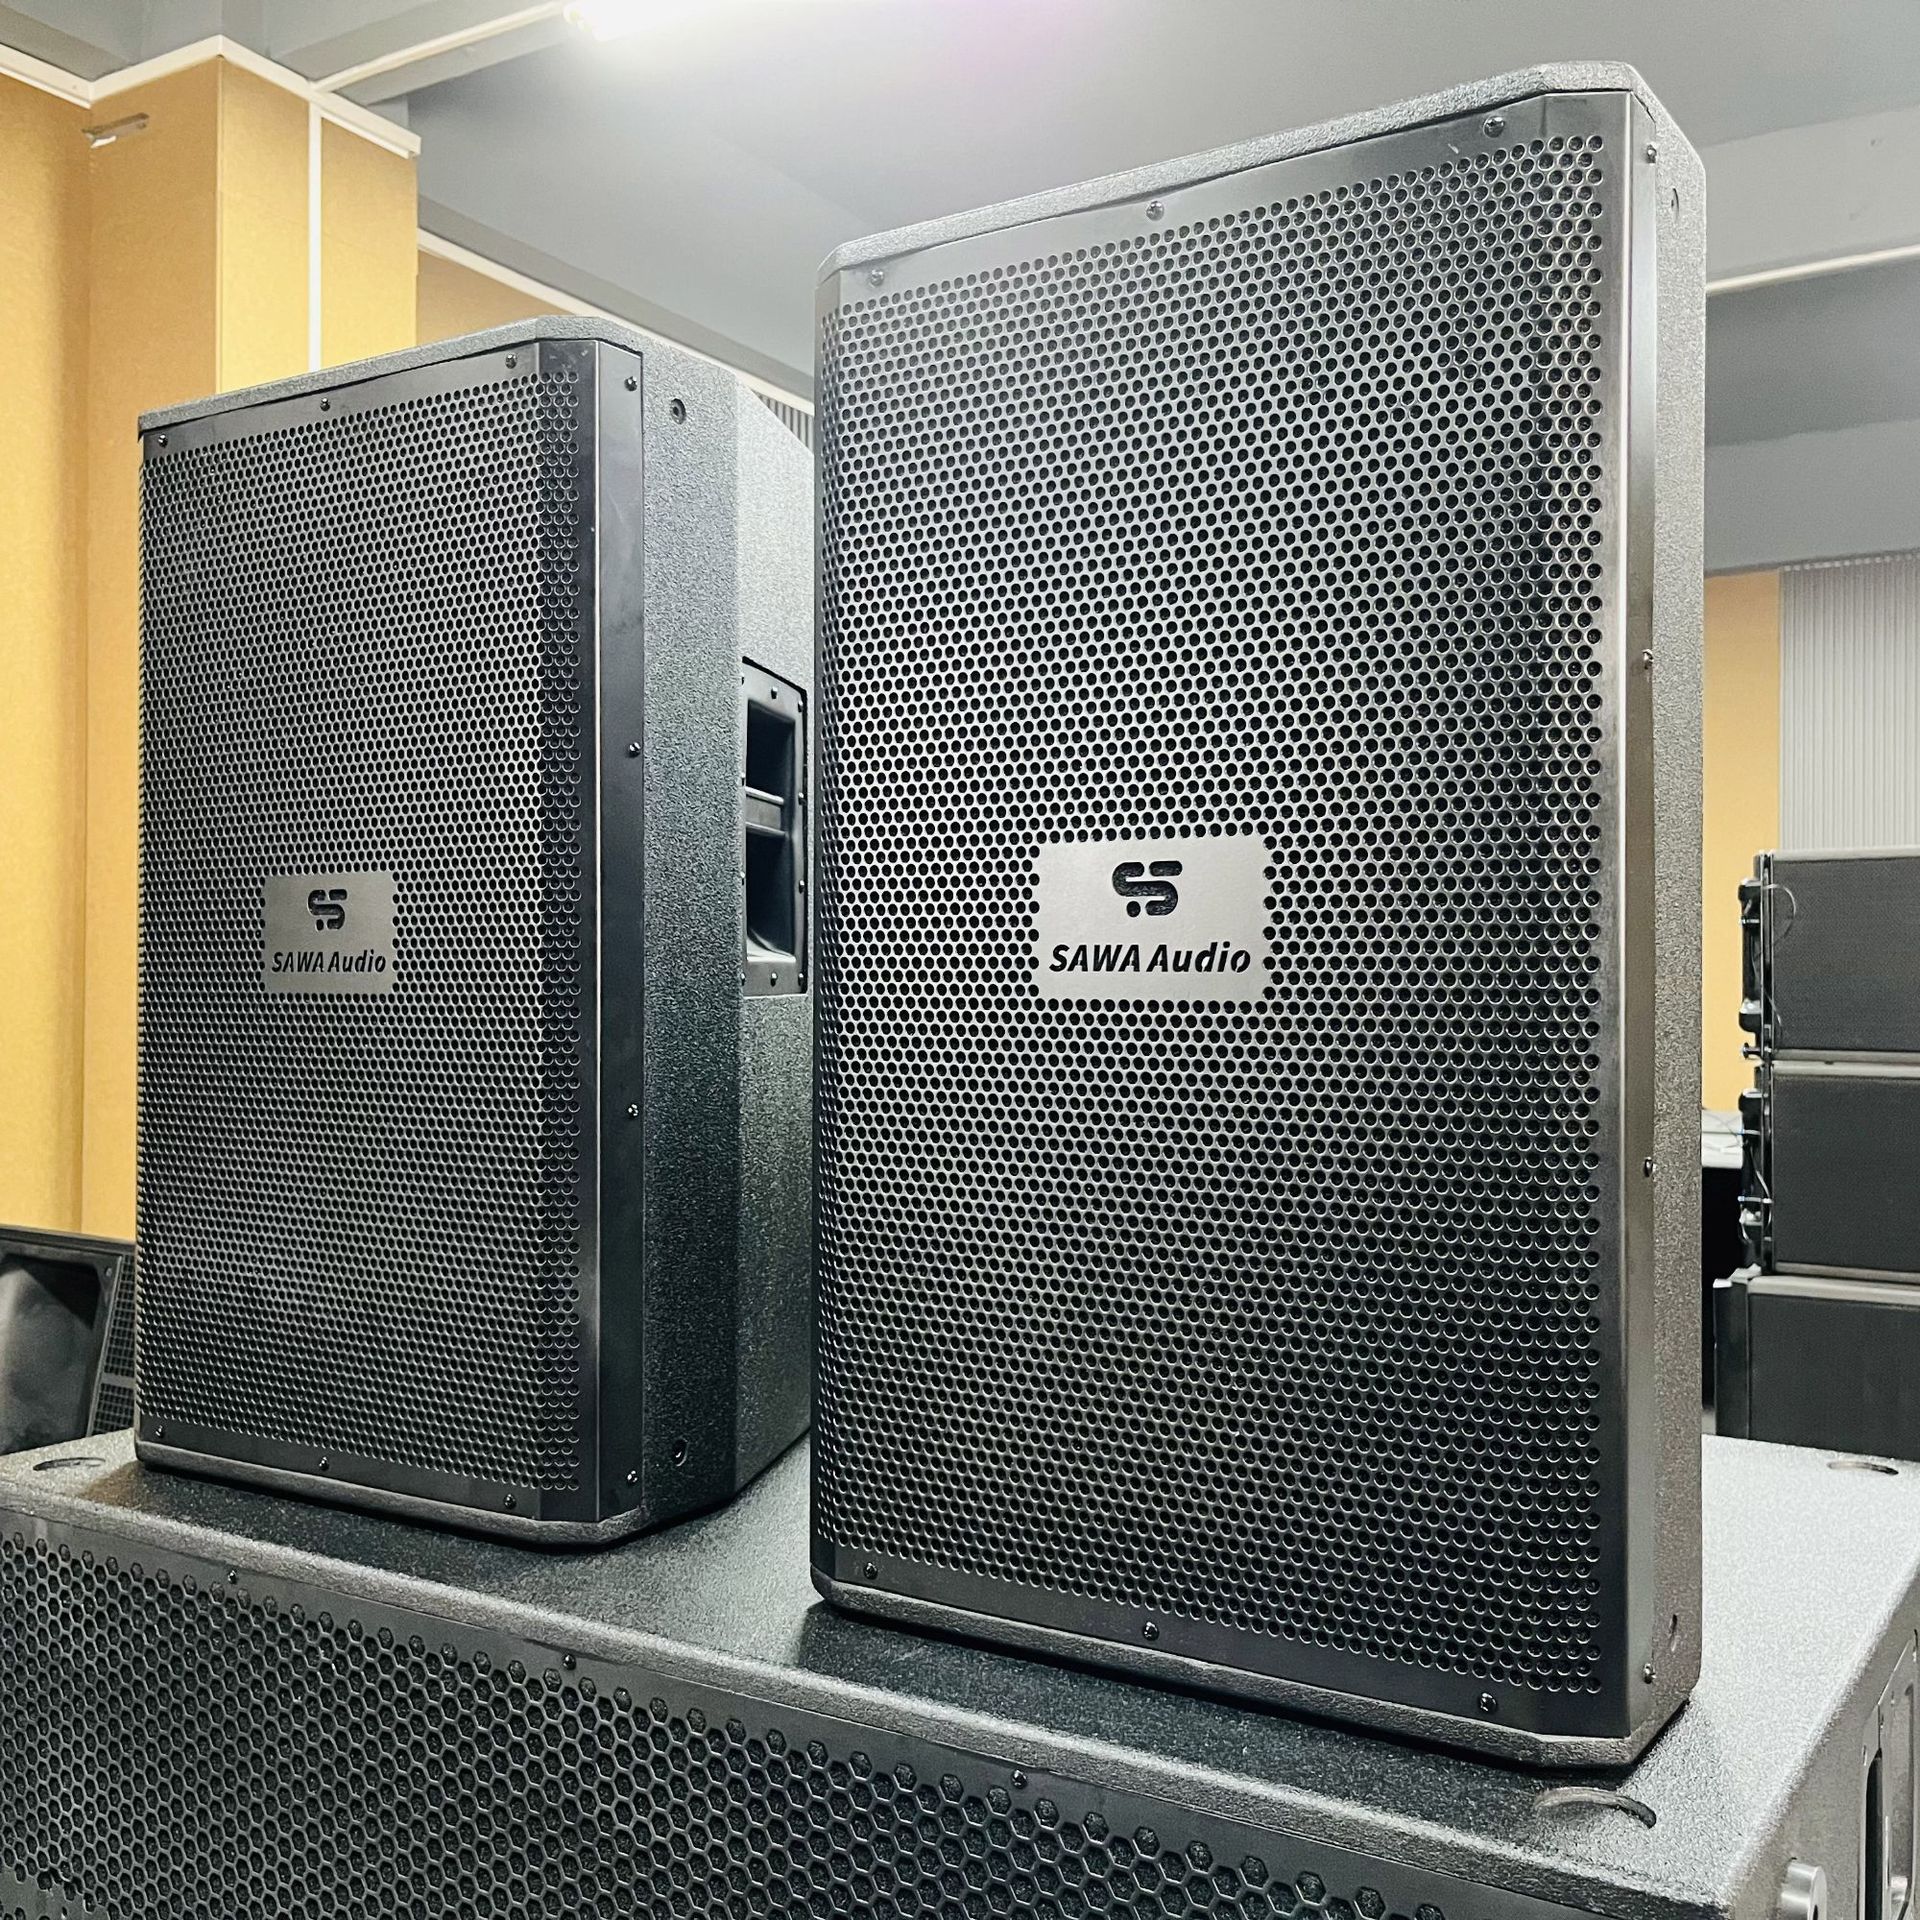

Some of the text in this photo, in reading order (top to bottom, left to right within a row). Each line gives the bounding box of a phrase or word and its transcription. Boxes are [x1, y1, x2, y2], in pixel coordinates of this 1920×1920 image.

[271, 948, 387, 973] SAWA Audio
[1049, 941, 1251, 972] SAWA Audio
